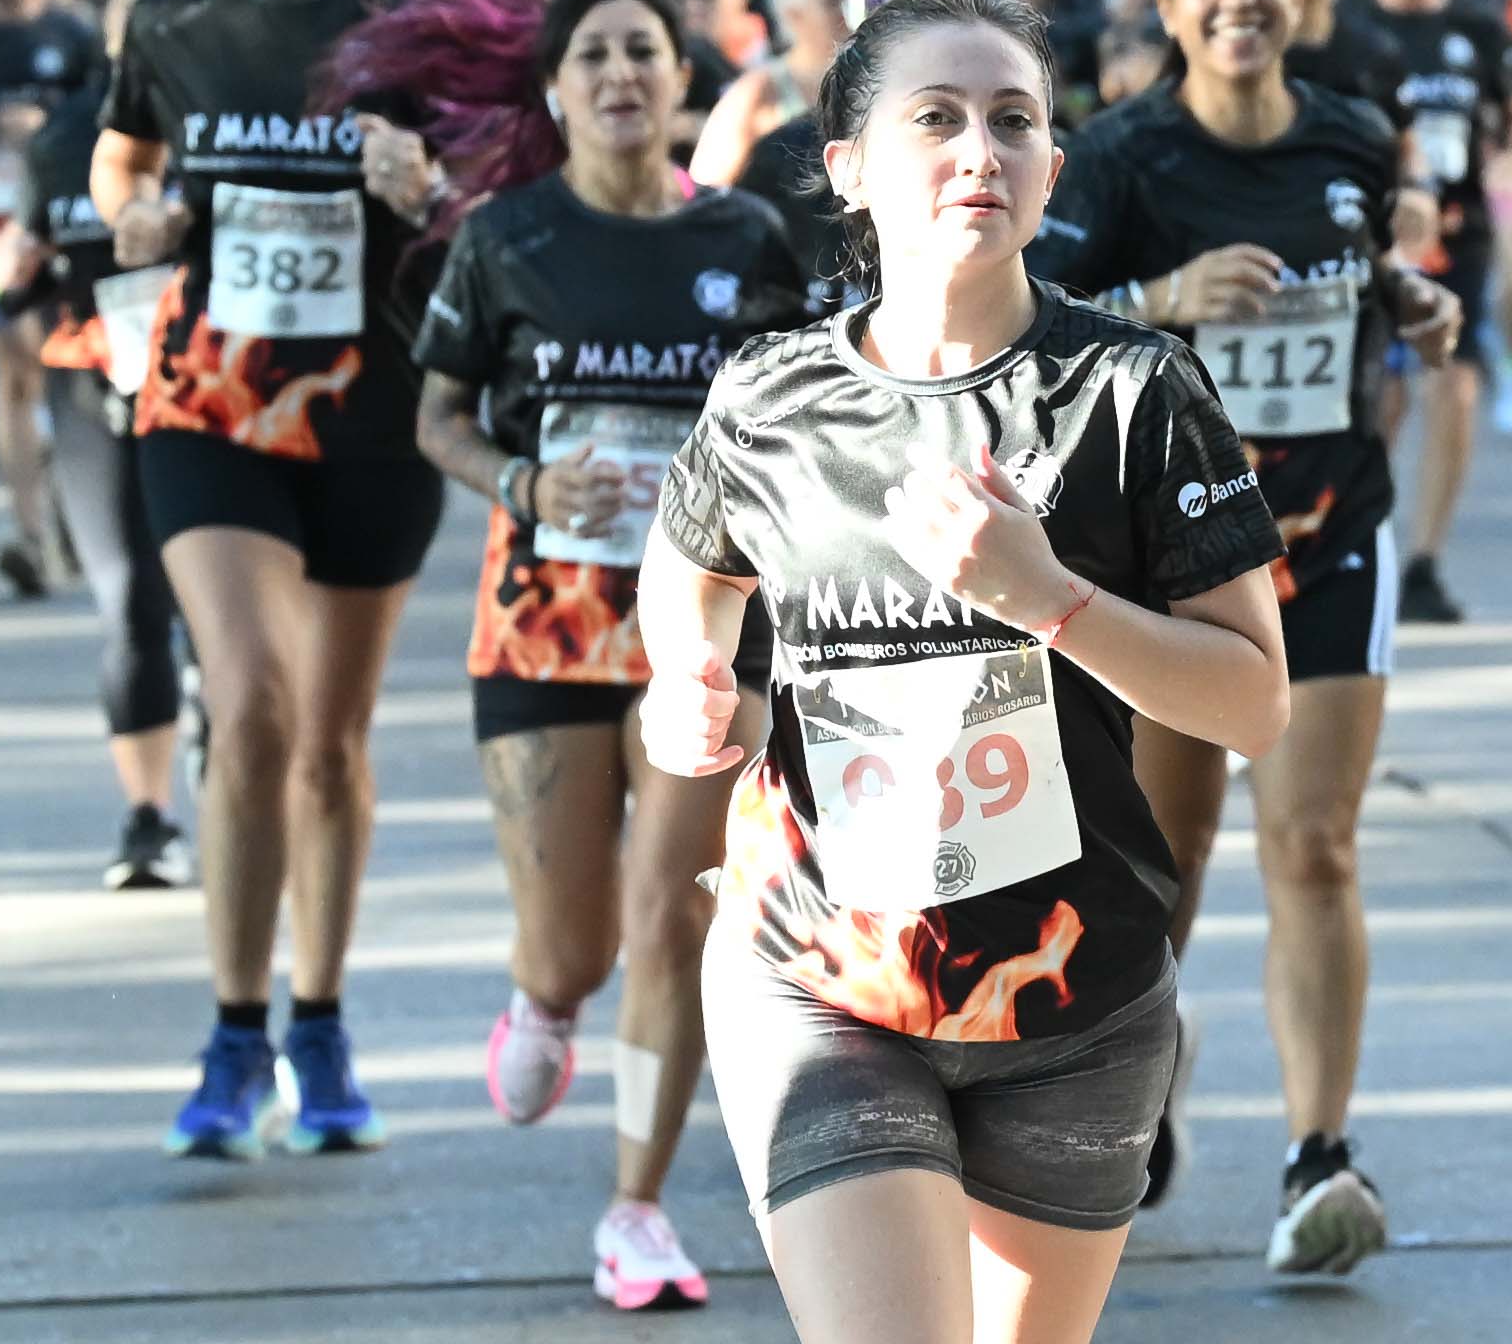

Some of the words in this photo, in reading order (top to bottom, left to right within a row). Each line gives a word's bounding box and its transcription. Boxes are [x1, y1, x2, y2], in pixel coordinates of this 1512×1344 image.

[215, 106, 364, 156] MARATÓ
[232, 243, 345, 294] 382
[574, 335, 722, 381] MARATÓ
[1220, 336, 1337, 389] 112
[1210, 470, 1259, 504] Banco
[824, 641, 907, 660] BOMBEROS
[997, 693, 1041, 716] ROSARIO
[935, 858, 959, 878] 27
